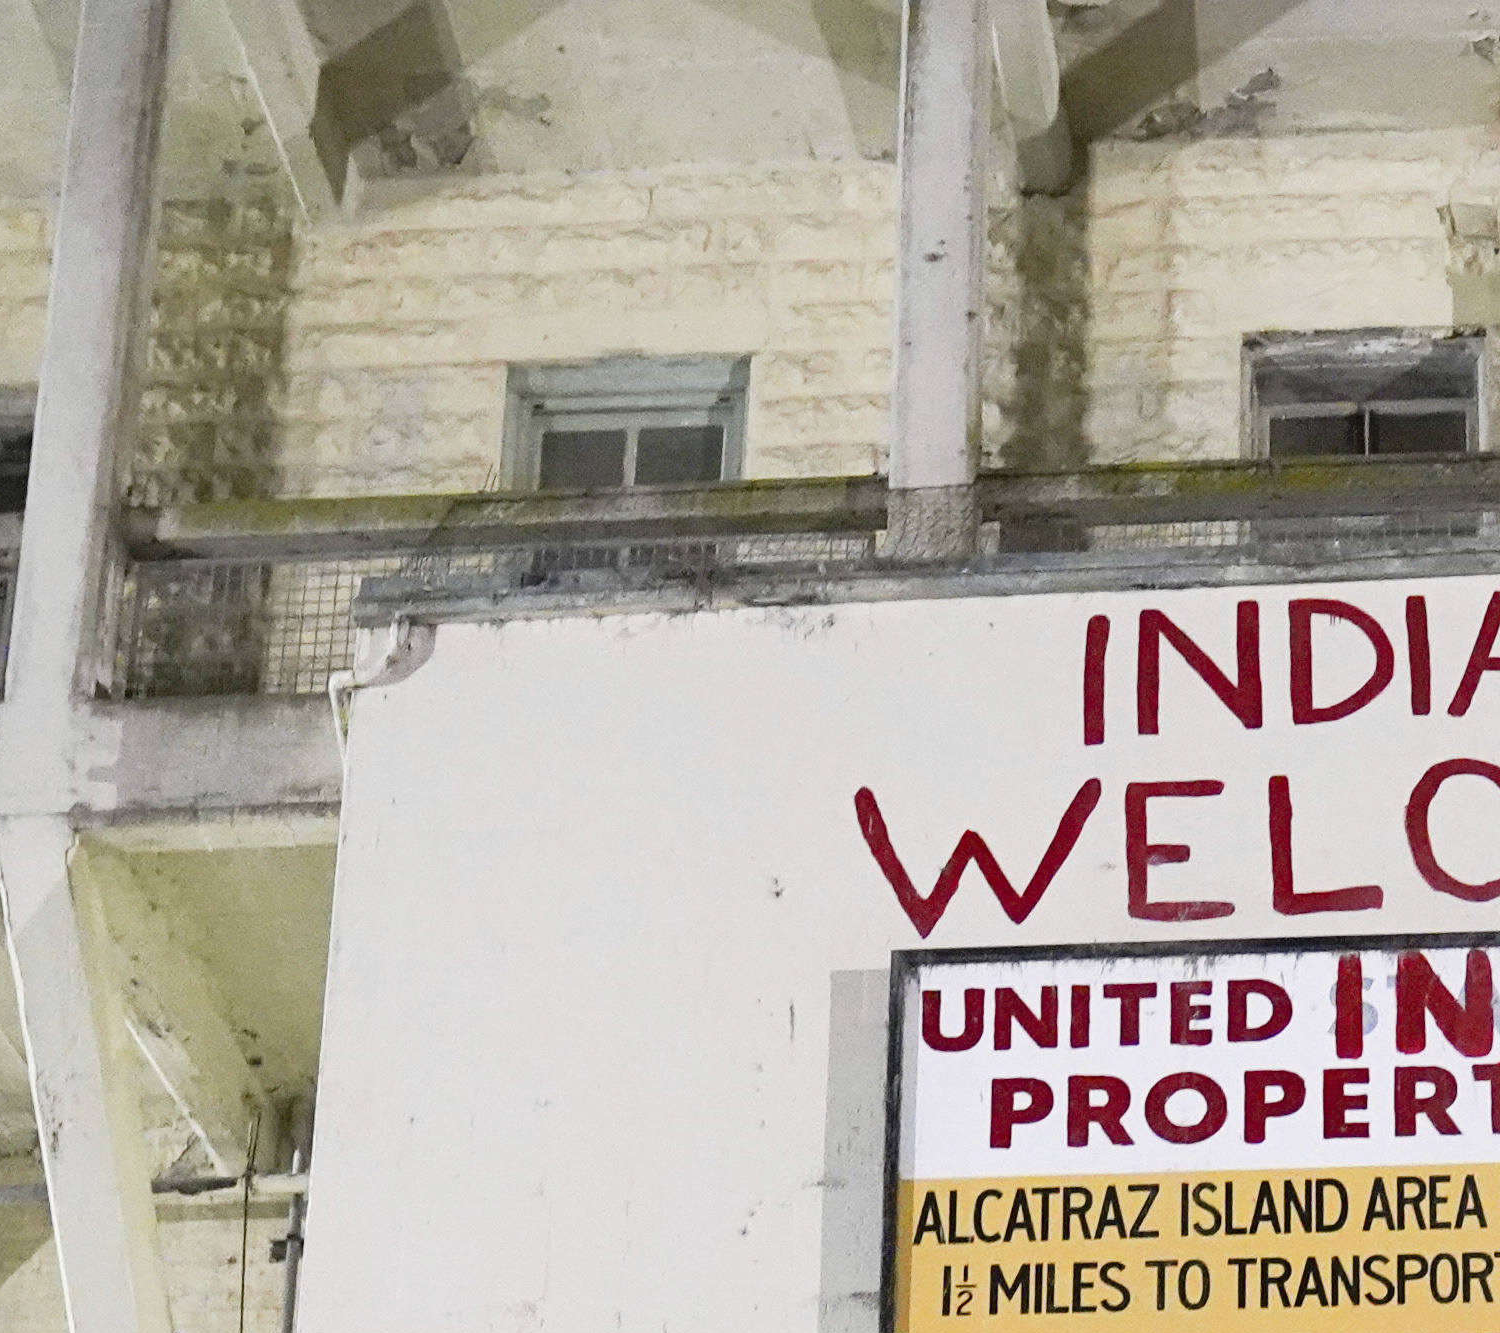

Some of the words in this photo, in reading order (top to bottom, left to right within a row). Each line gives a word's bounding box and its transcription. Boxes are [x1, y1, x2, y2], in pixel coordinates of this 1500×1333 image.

[921, 977, 1293, 1054] UNITED
[912, 1182, 1161, 1246] ALCATRAZ
[1179, 1177, 1350, 1237] ISLAND
[1361, 1173, 1489, 1233] AREA
[988, 1260, 1131, 1316] MILES
[1155, 1258, 1211, 1311] TO
